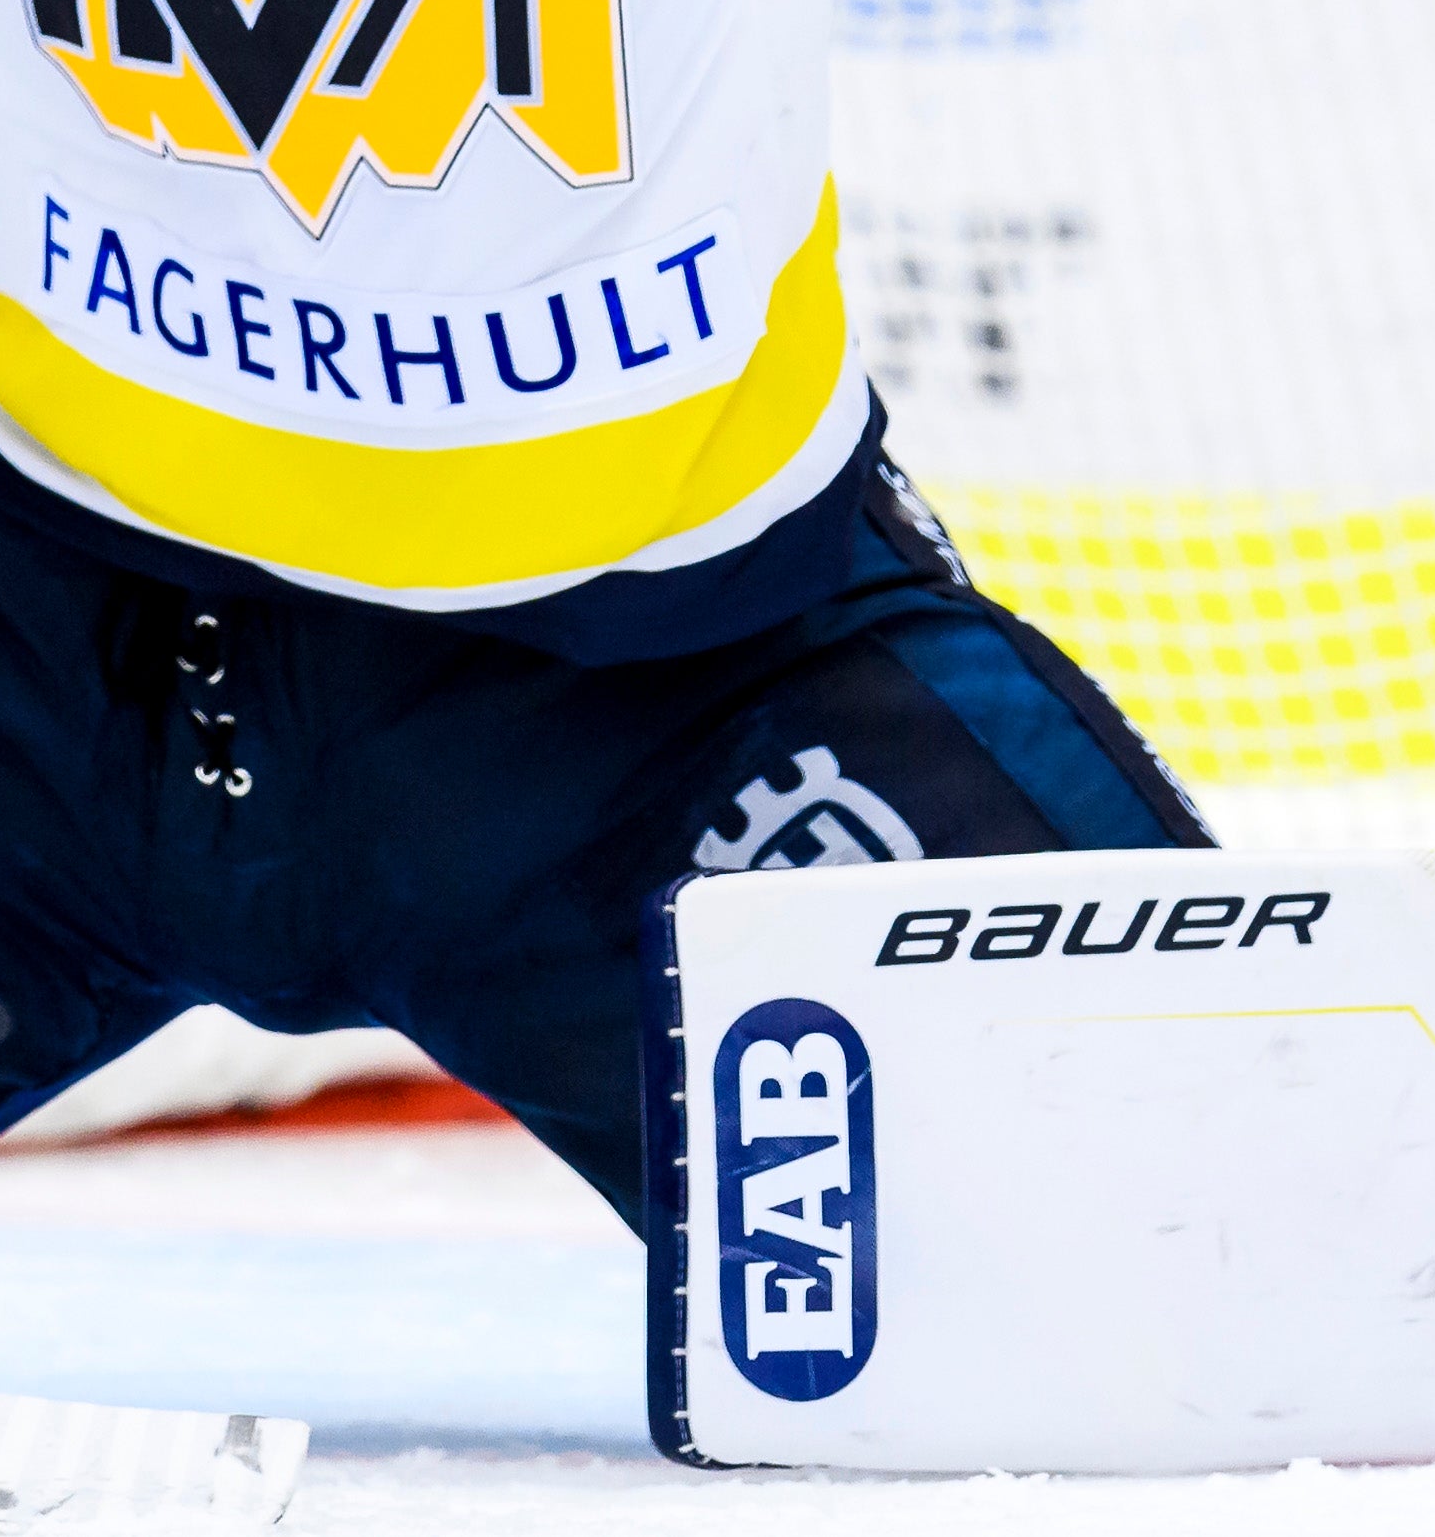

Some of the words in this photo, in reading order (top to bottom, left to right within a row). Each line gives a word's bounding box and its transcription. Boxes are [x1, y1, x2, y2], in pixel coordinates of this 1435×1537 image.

[41, 194, 719, 406] FAGERHULT
[874, 891, 1331, 967] BAUER
[737, 1031, 856, 1361] EAB
